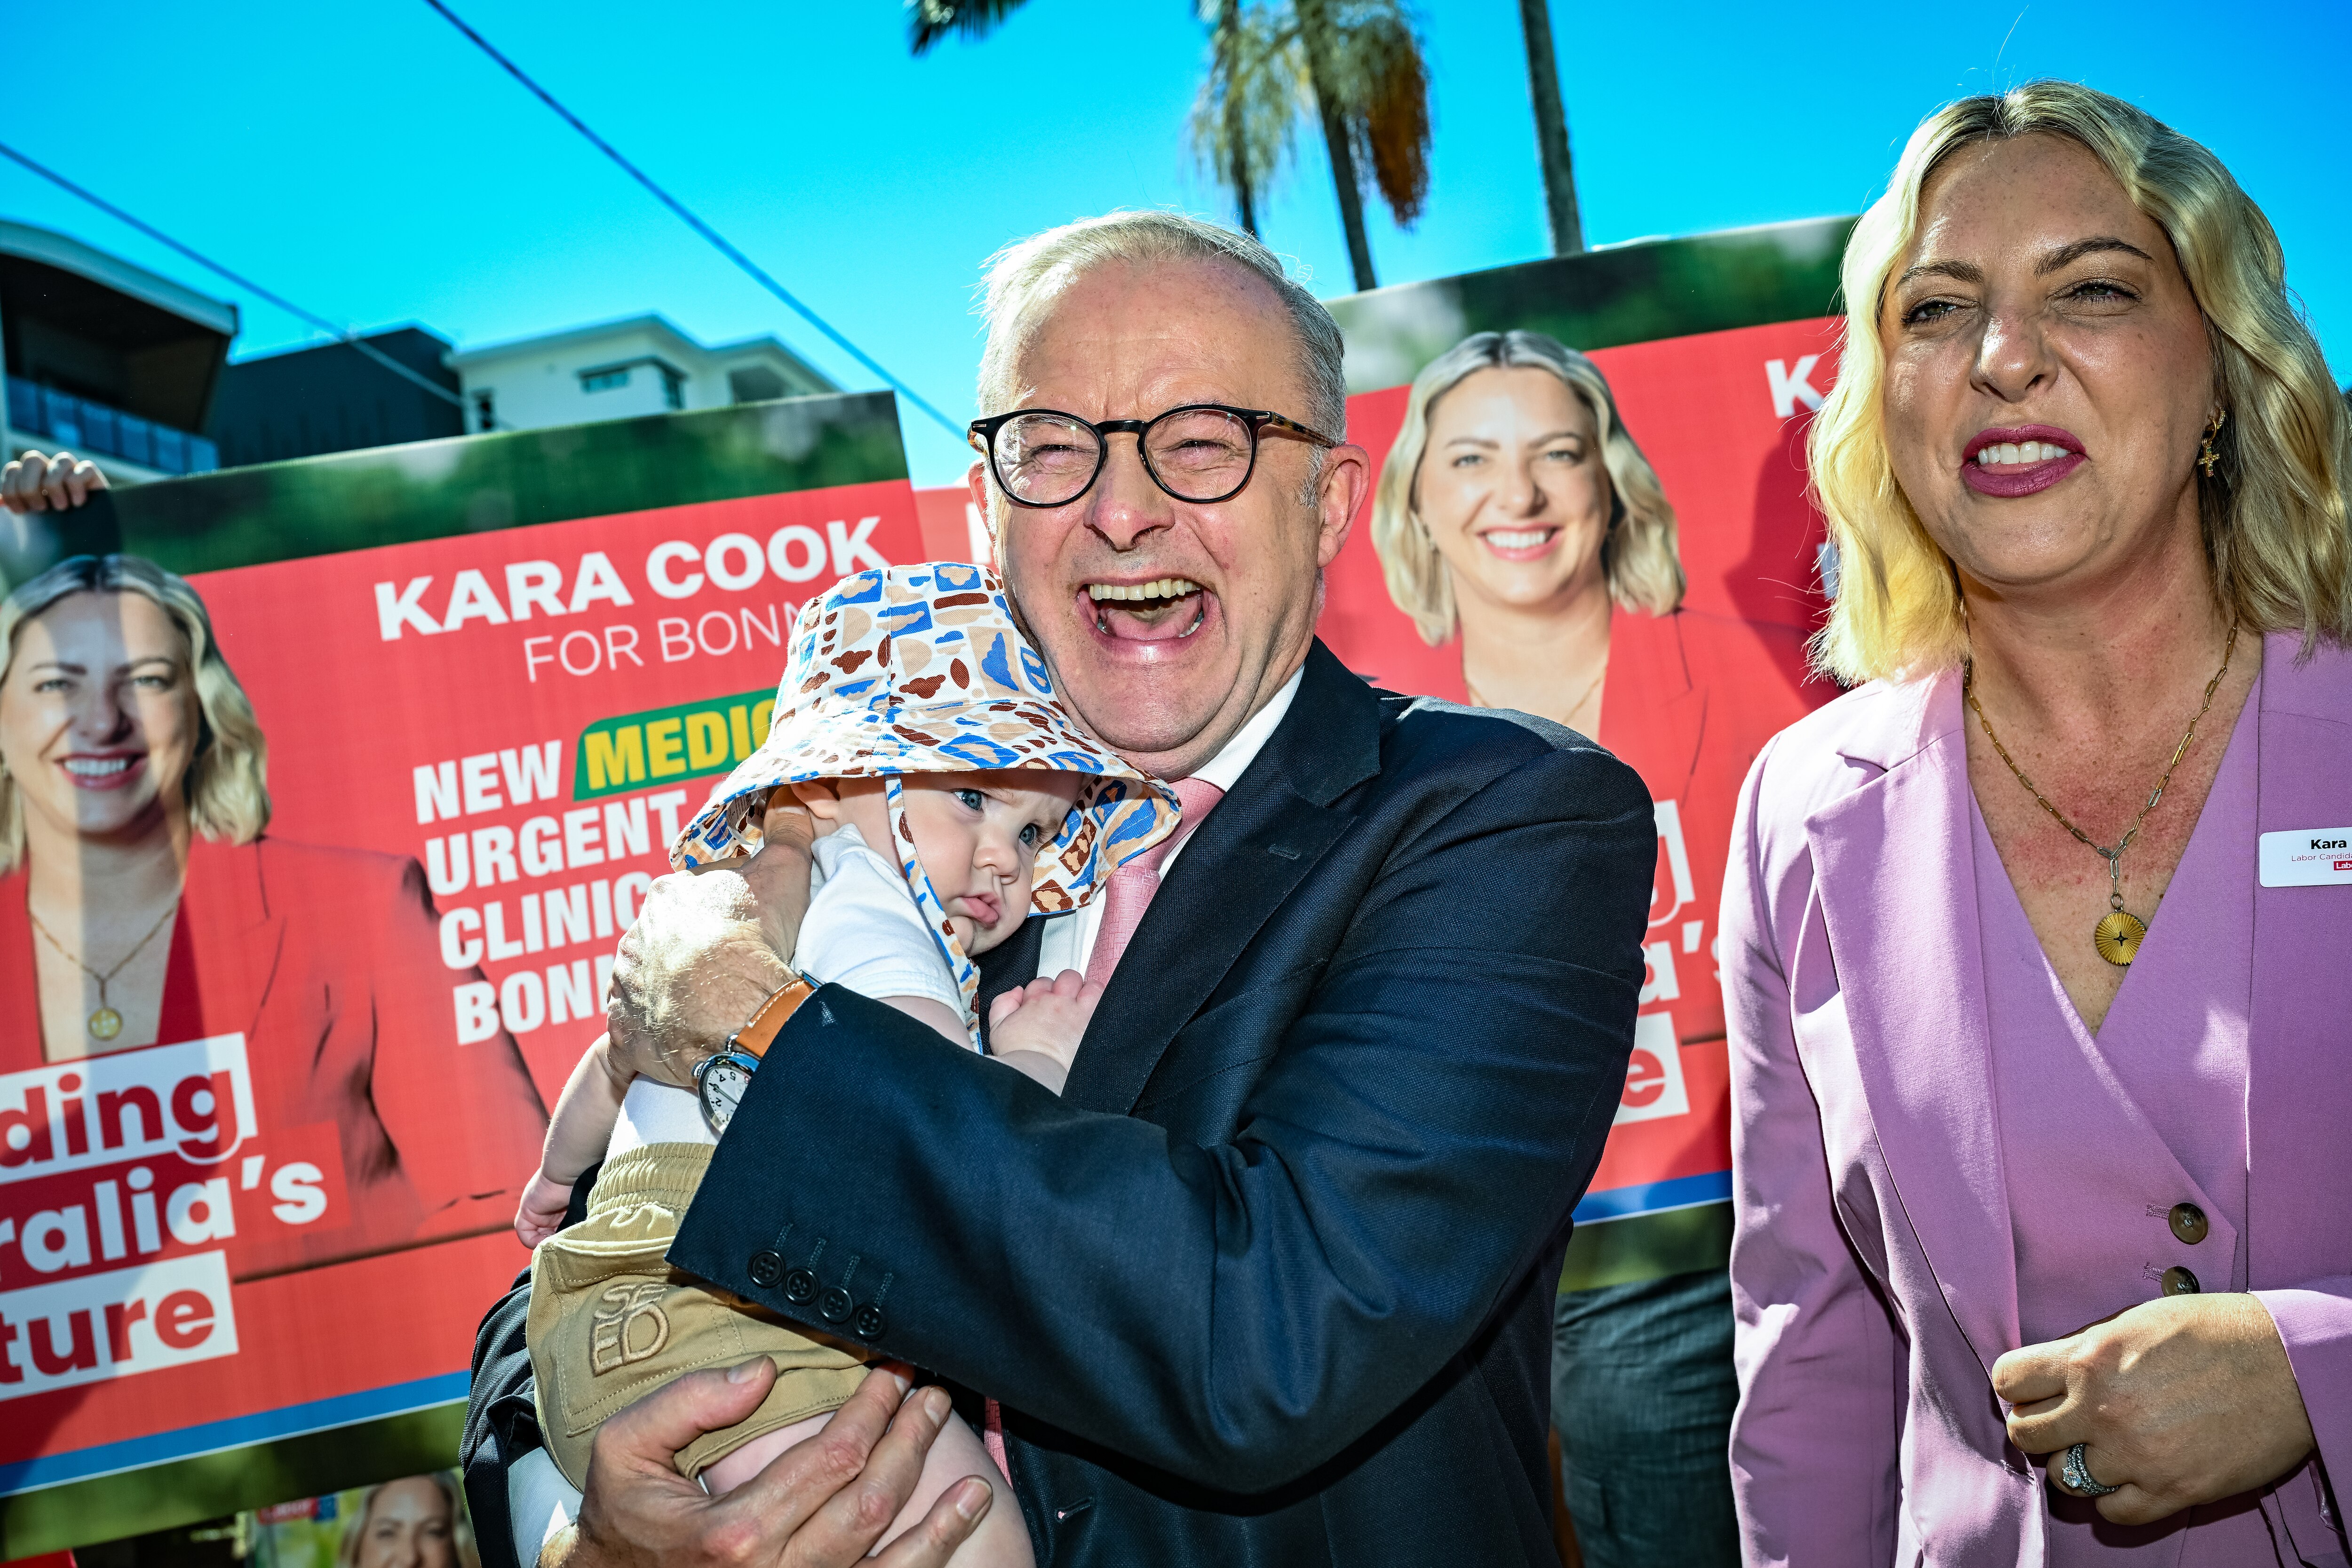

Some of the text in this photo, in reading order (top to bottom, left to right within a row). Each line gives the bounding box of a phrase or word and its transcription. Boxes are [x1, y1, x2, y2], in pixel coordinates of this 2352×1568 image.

[374, 551, 634, 642] KARA
[646, 516, 892, 599] COOK
[524, 624, 644, 683] FOR
[413, 740, 562, 825] NEW
[425, 789, 687, 896] URGENT
[2311, 839, 2347, 850] Kara
